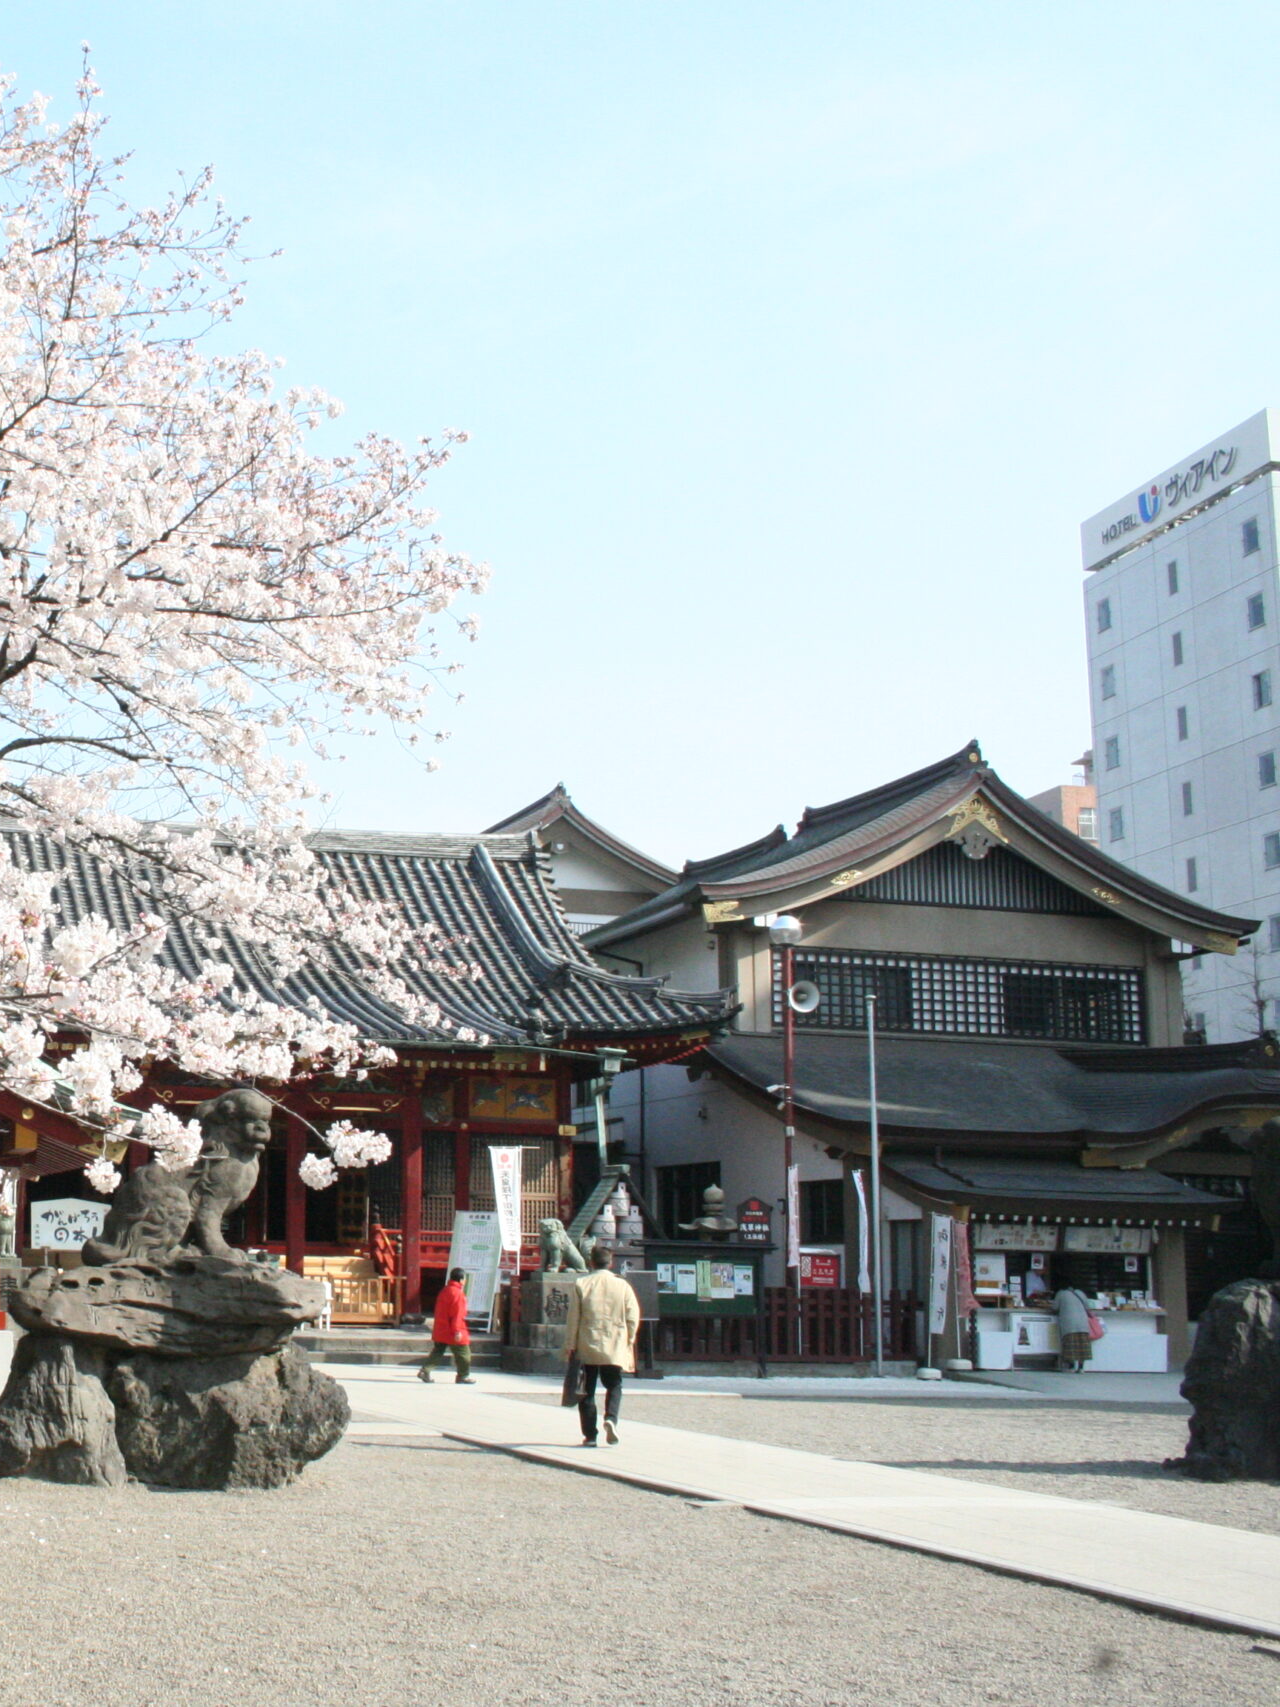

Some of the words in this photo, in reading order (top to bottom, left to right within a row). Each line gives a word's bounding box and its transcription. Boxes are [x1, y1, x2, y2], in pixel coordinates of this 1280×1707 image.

[1164, 446, 1237, 506] ヴィアイン
[1101, 514, 1138, 544] HOTEL
[40, 1208, 99, 1226] がんばろう
